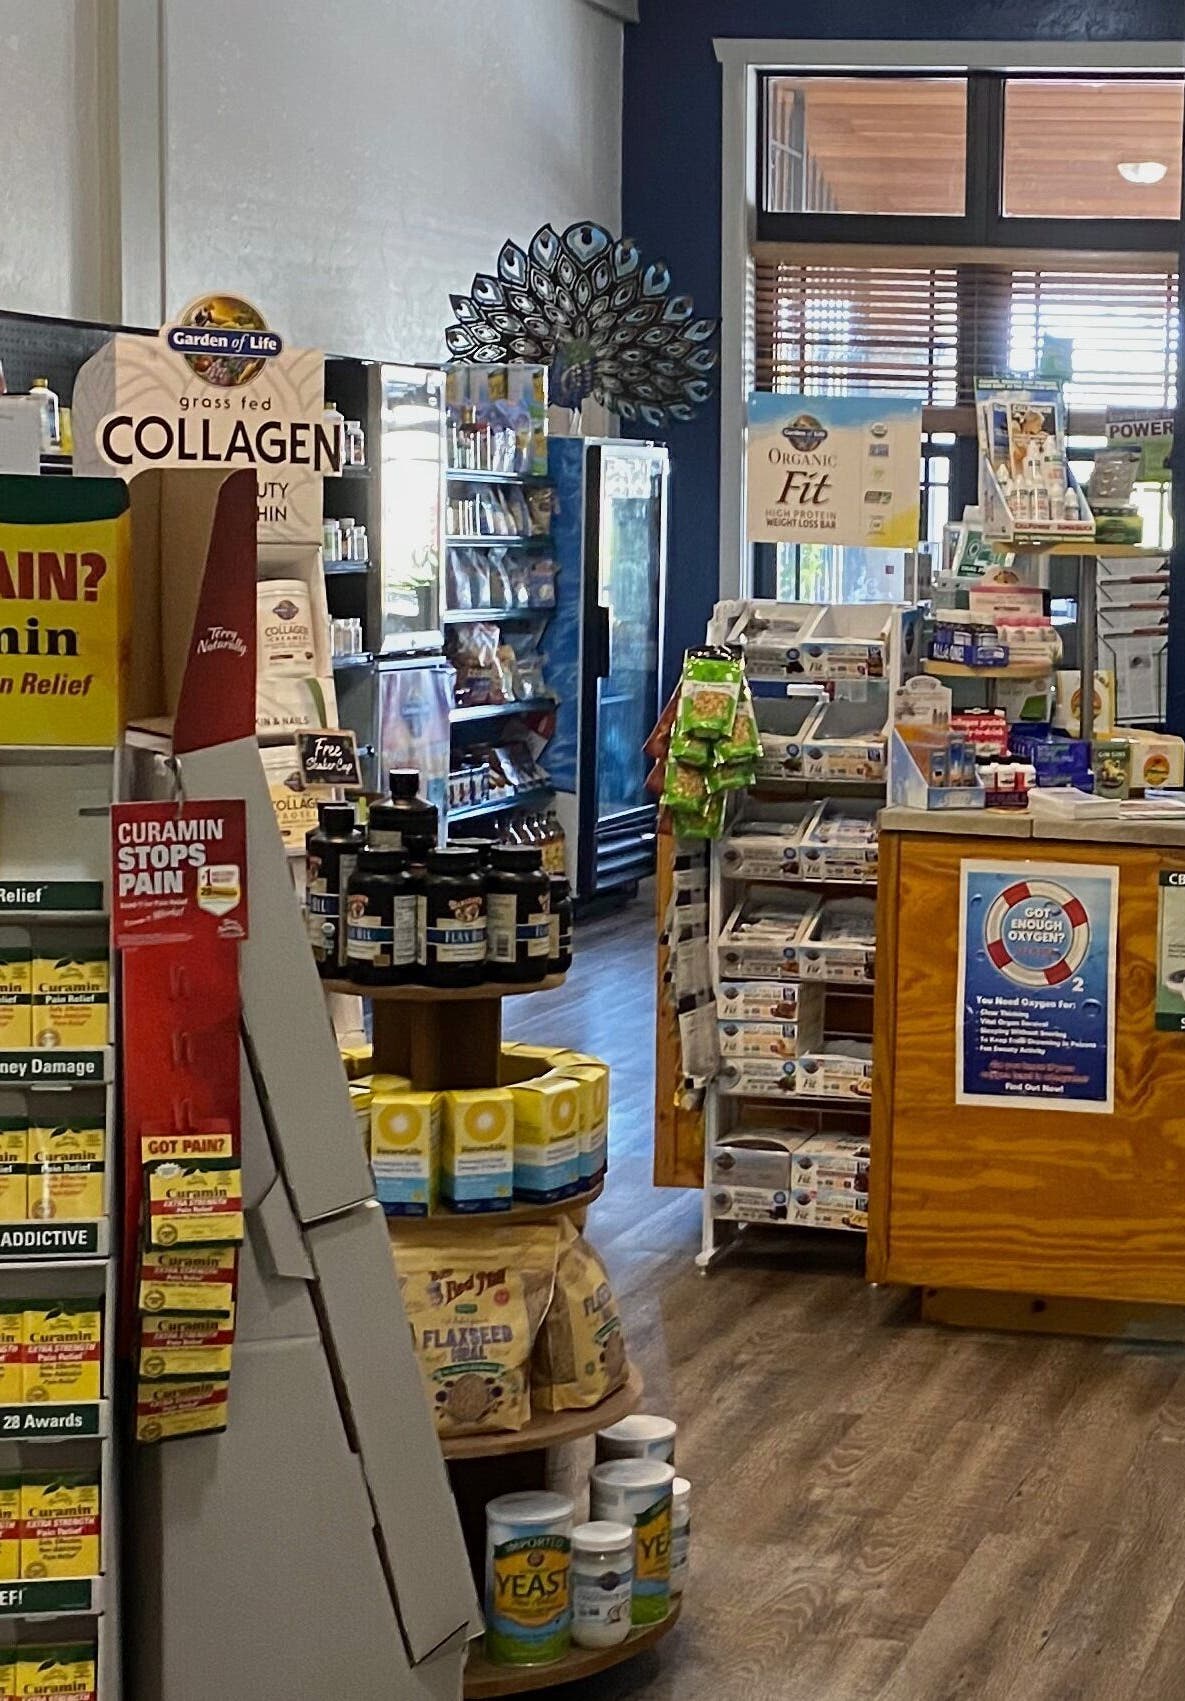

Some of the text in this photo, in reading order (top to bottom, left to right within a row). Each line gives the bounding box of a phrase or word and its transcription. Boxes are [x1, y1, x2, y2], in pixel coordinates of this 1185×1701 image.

[173, 331, 278, 351] Garden of Life
[179, 395, 272, 411] grass fed
[1109, 421, 1174, 439] POWER
[102, 415, 341, 473] COLLAGEN
[768, 447, 838, 468] ORGANIC
[776, 470, 835, 505] Fit
[766, 509, 837, 520] HIGH PROTEIN
[766, 518, 837, 529] WEIGHT LOSS BAR
[207, 626, 239, 641] Terry
[197, 636, 247, 657] Naturally
[20, 671, 94, 697] Relief
[314, 737, 343, 758] Free
[118, 819, 224, 845] CURAMIN
[118, 843, 206, 871] STOPS
[119, 870, 184, 897] PAIN
[1025, 907, 1050, 919] GOT
[1011, 919, 1063, 932] ENOUGH
[1008, 931, 1065, 943] OXYGEN?
[38, 982, 101, 993] Curamin
[1071, 976, 1084, 993] 2
[976, 995, 993, 1005] You
[995, 996, 1020, 1006] Need
[1021, 998, 1057, 1009] Oxygen
[31, 1058, 95, 1077] Damage
[1005, 1082, 1023, 1091] Find
[1024, 1084, 1041, 1092] Out
[147, 1138, 225, 1154] GOT PAIN?
[33, 1151, 97, 1163] Curamin
[165, 1187, 228, 1199] Curamin
[0, 1229, 88, 1249] ADDICTIVE
[30, 1331, 93, 1343] Curamin
[422, 1324, 515, 1349] FLAXSEED
[3, 1412, 83, 1431] 28 Awards
[28, 1504, 93, 1518] Curamin
[496, 1567, 569, 1598] YEAST
[23, 1680, 87, 1695] Curamin
